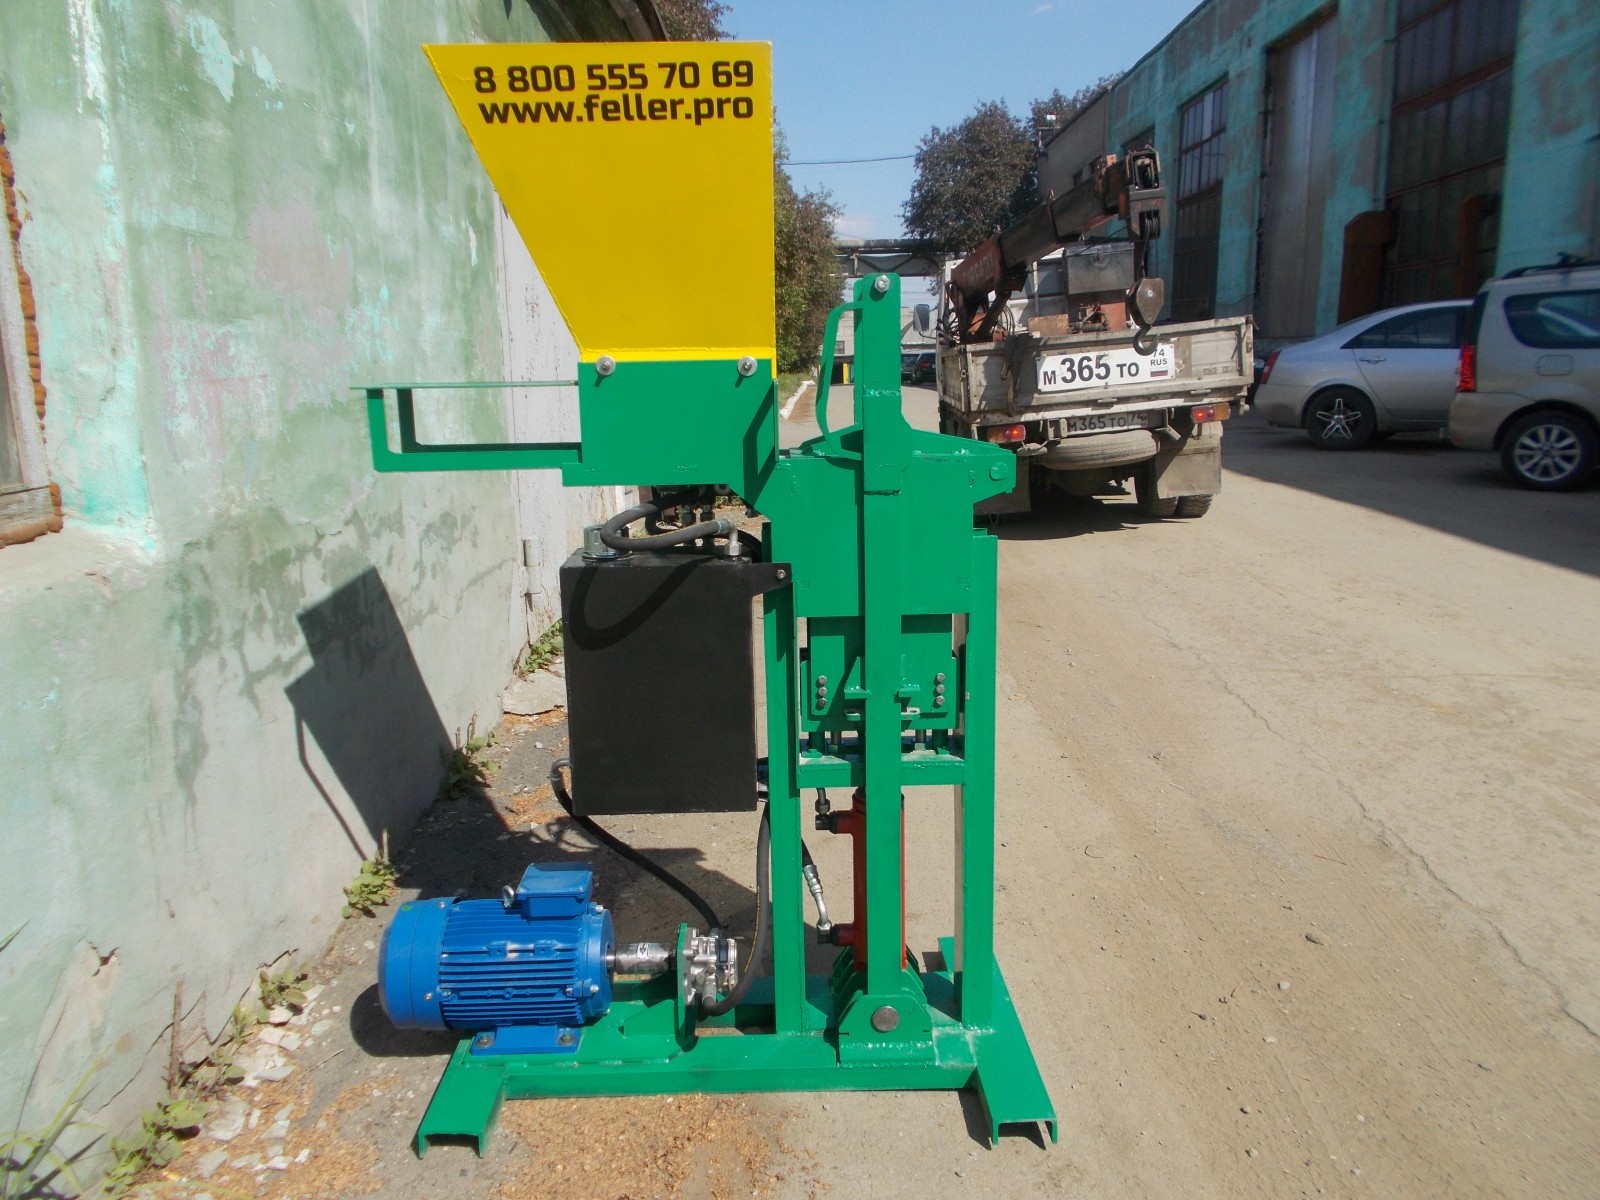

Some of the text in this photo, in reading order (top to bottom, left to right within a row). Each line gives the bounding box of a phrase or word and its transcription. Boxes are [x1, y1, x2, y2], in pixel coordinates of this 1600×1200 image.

[474, 60, 754, 93] 8 800 555 70 69
[478, 93, 754, 125] www.feller.pro
[1116, 362, 1139, 378] TO
[1150, 358, 1168, 366] RUS
